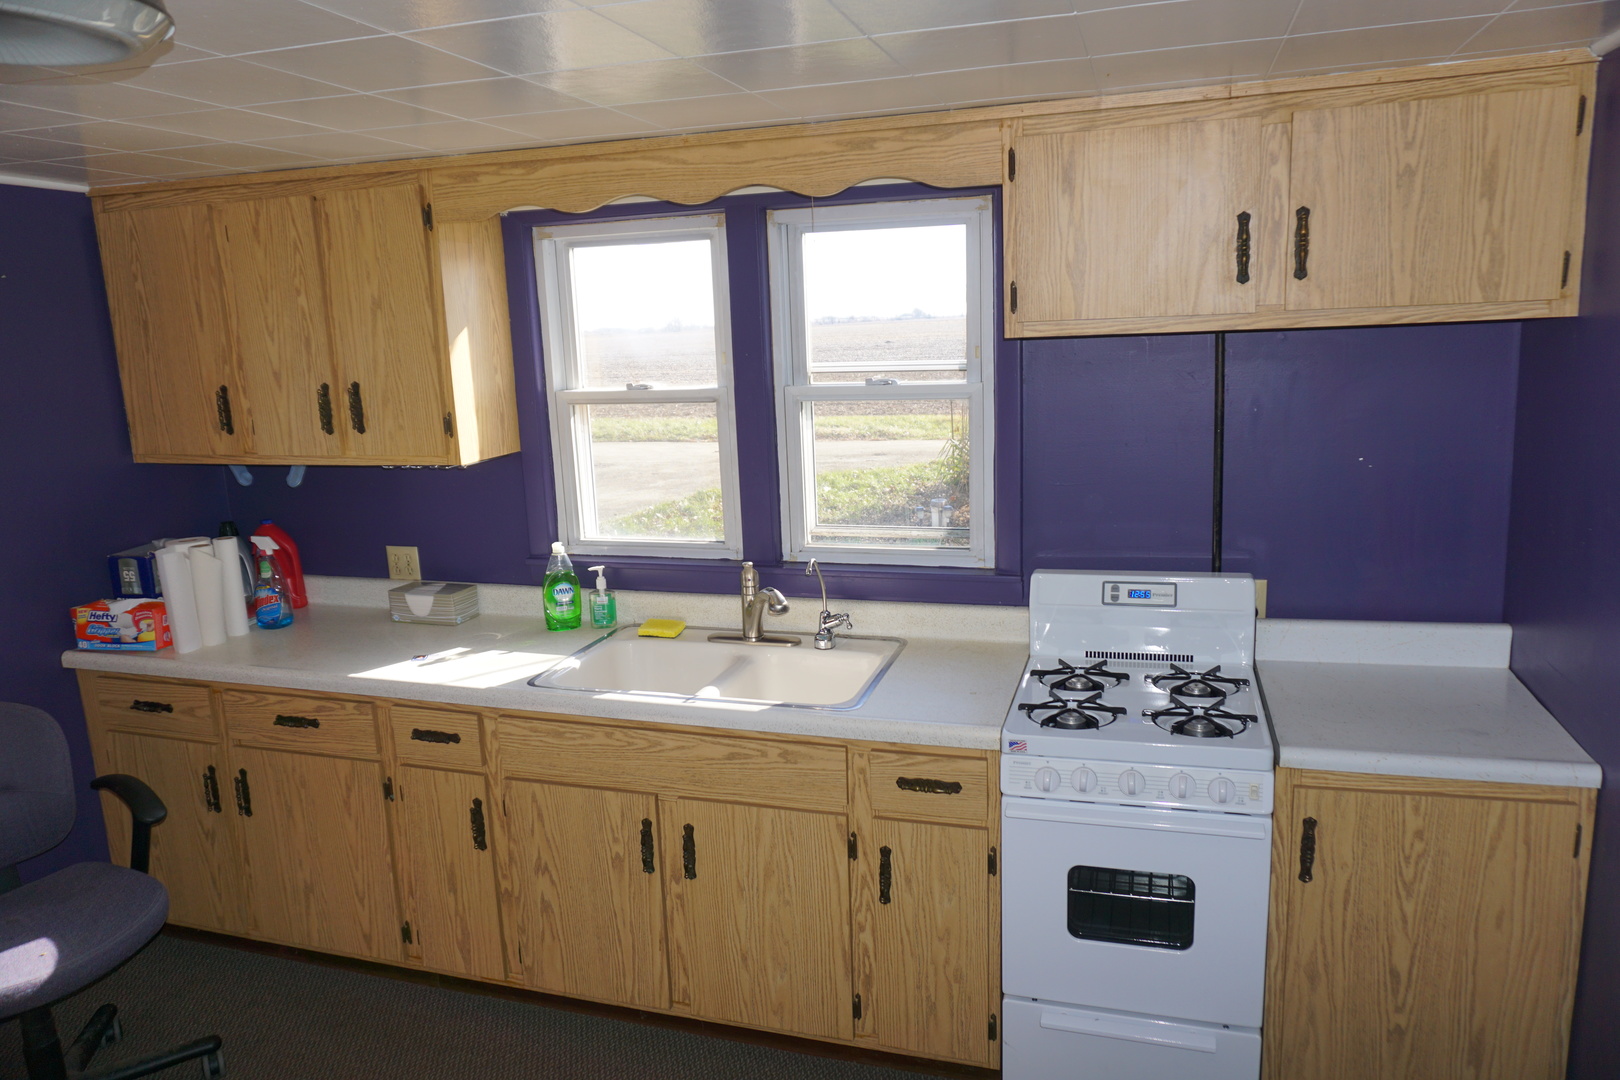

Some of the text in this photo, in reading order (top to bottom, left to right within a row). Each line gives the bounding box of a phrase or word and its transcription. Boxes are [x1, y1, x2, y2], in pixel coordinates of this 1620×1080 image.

[123, 570, 136, 581] 55
[552, 587, 574, 595] DAWN
[89, 611, 116, 622] Hefty
